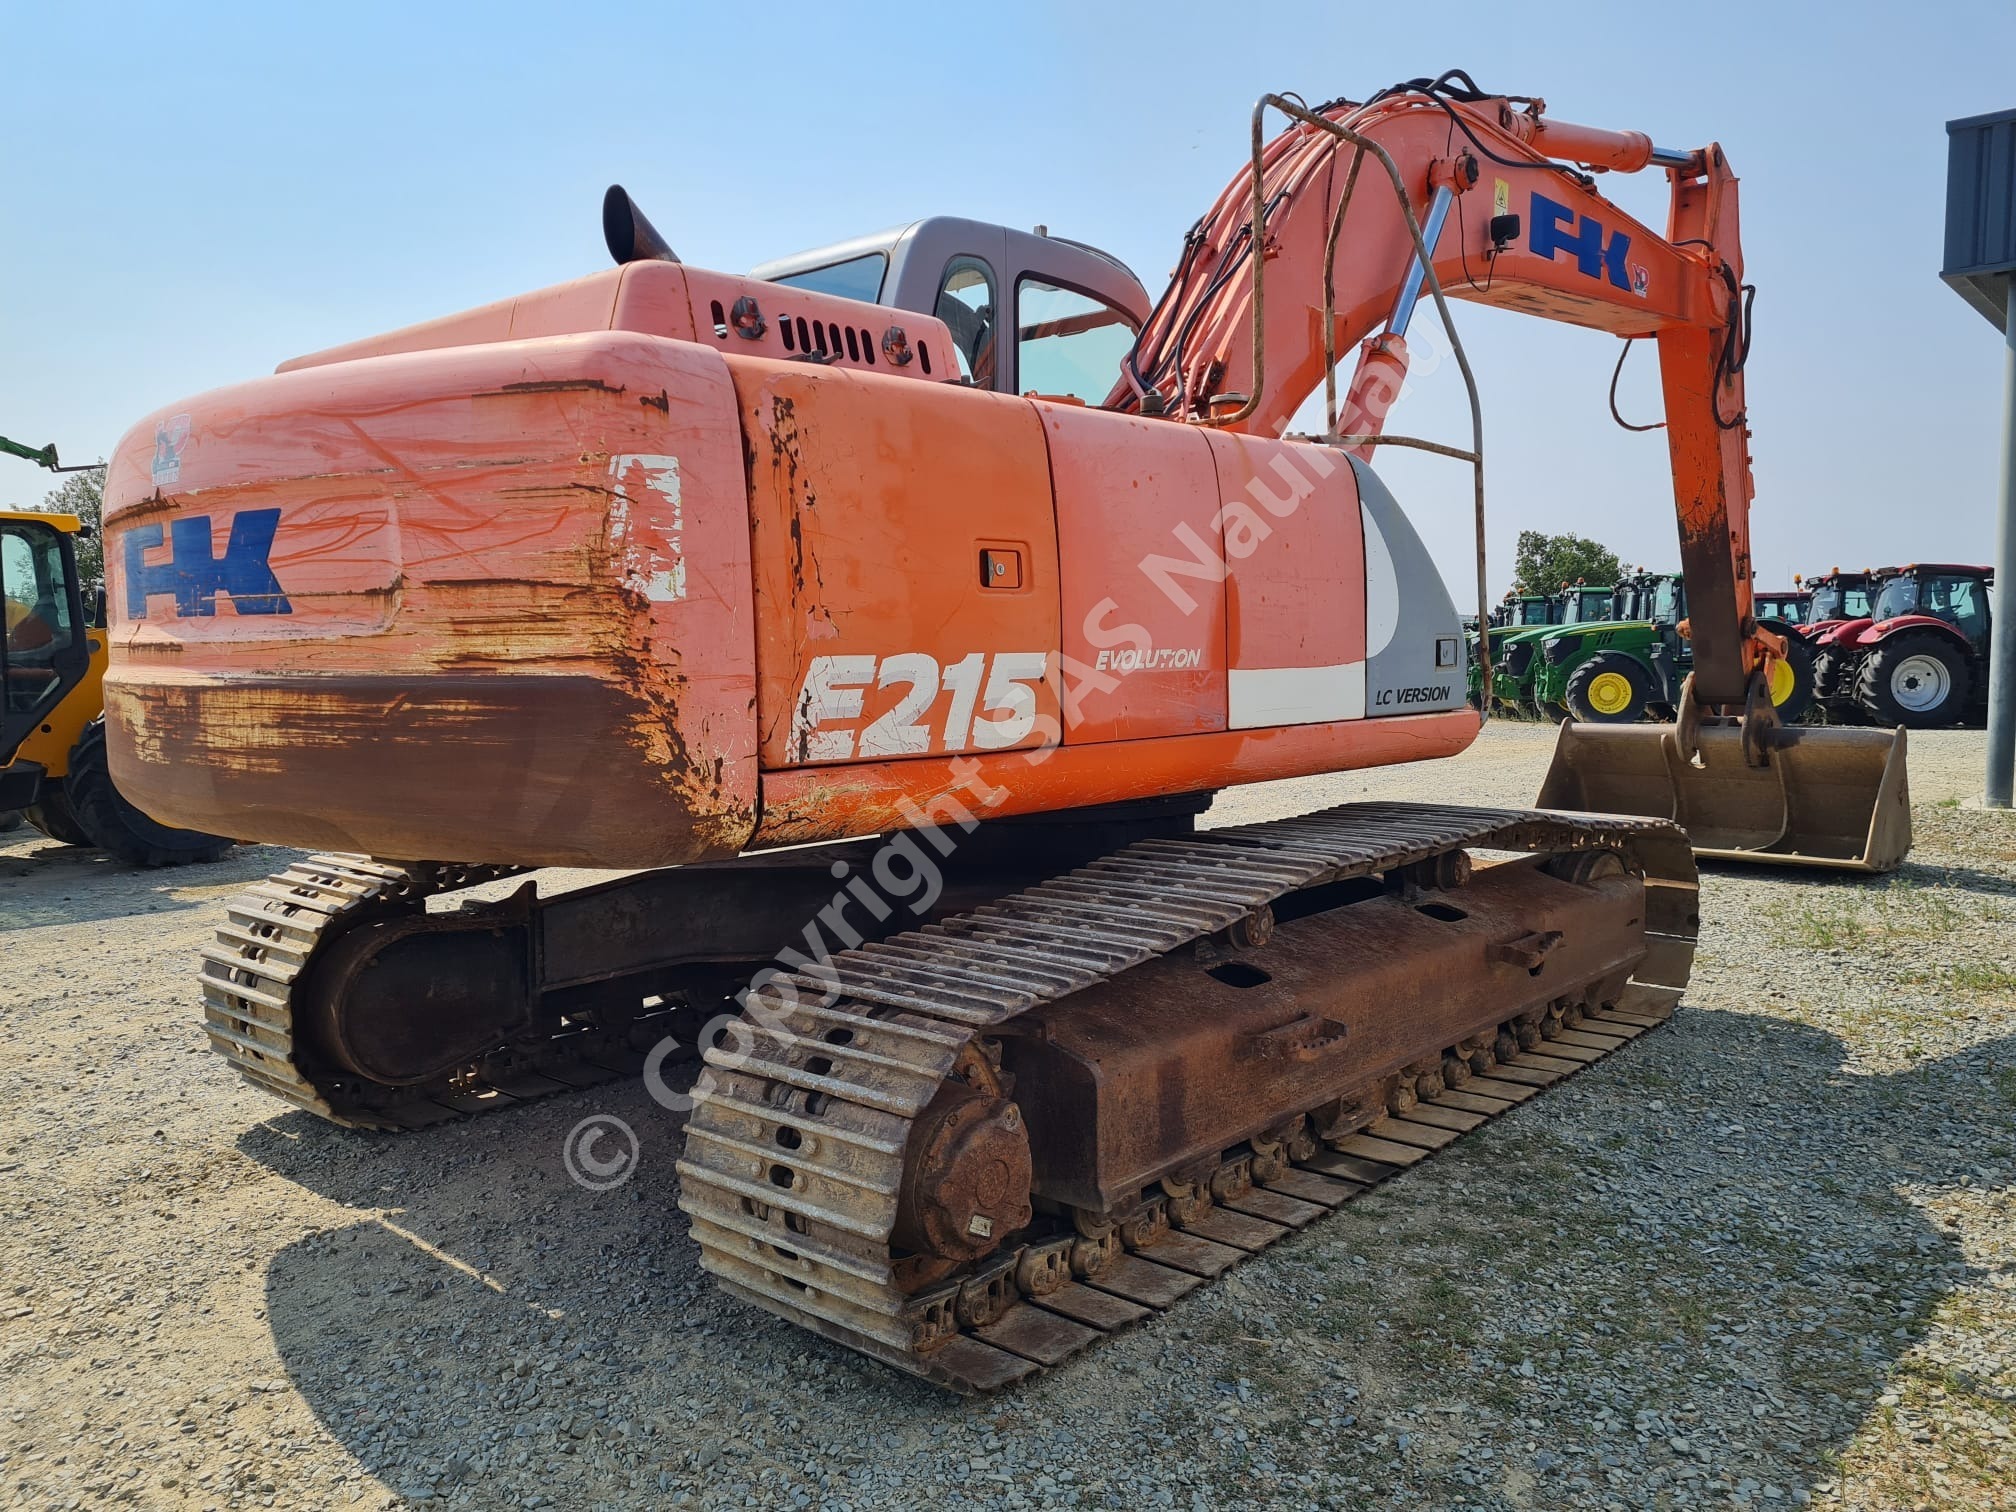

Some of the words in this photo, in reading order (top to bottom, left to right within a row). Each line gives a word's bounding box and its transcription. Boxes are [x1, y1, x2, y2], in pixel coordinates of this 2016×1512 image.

[1095, 648, 1201, 671] EVOLUTION
[785, 652, 1047, 763] E215
[1375, 689, 1393, 706] LC
[1396, 686, 1451, 704] VERSION
